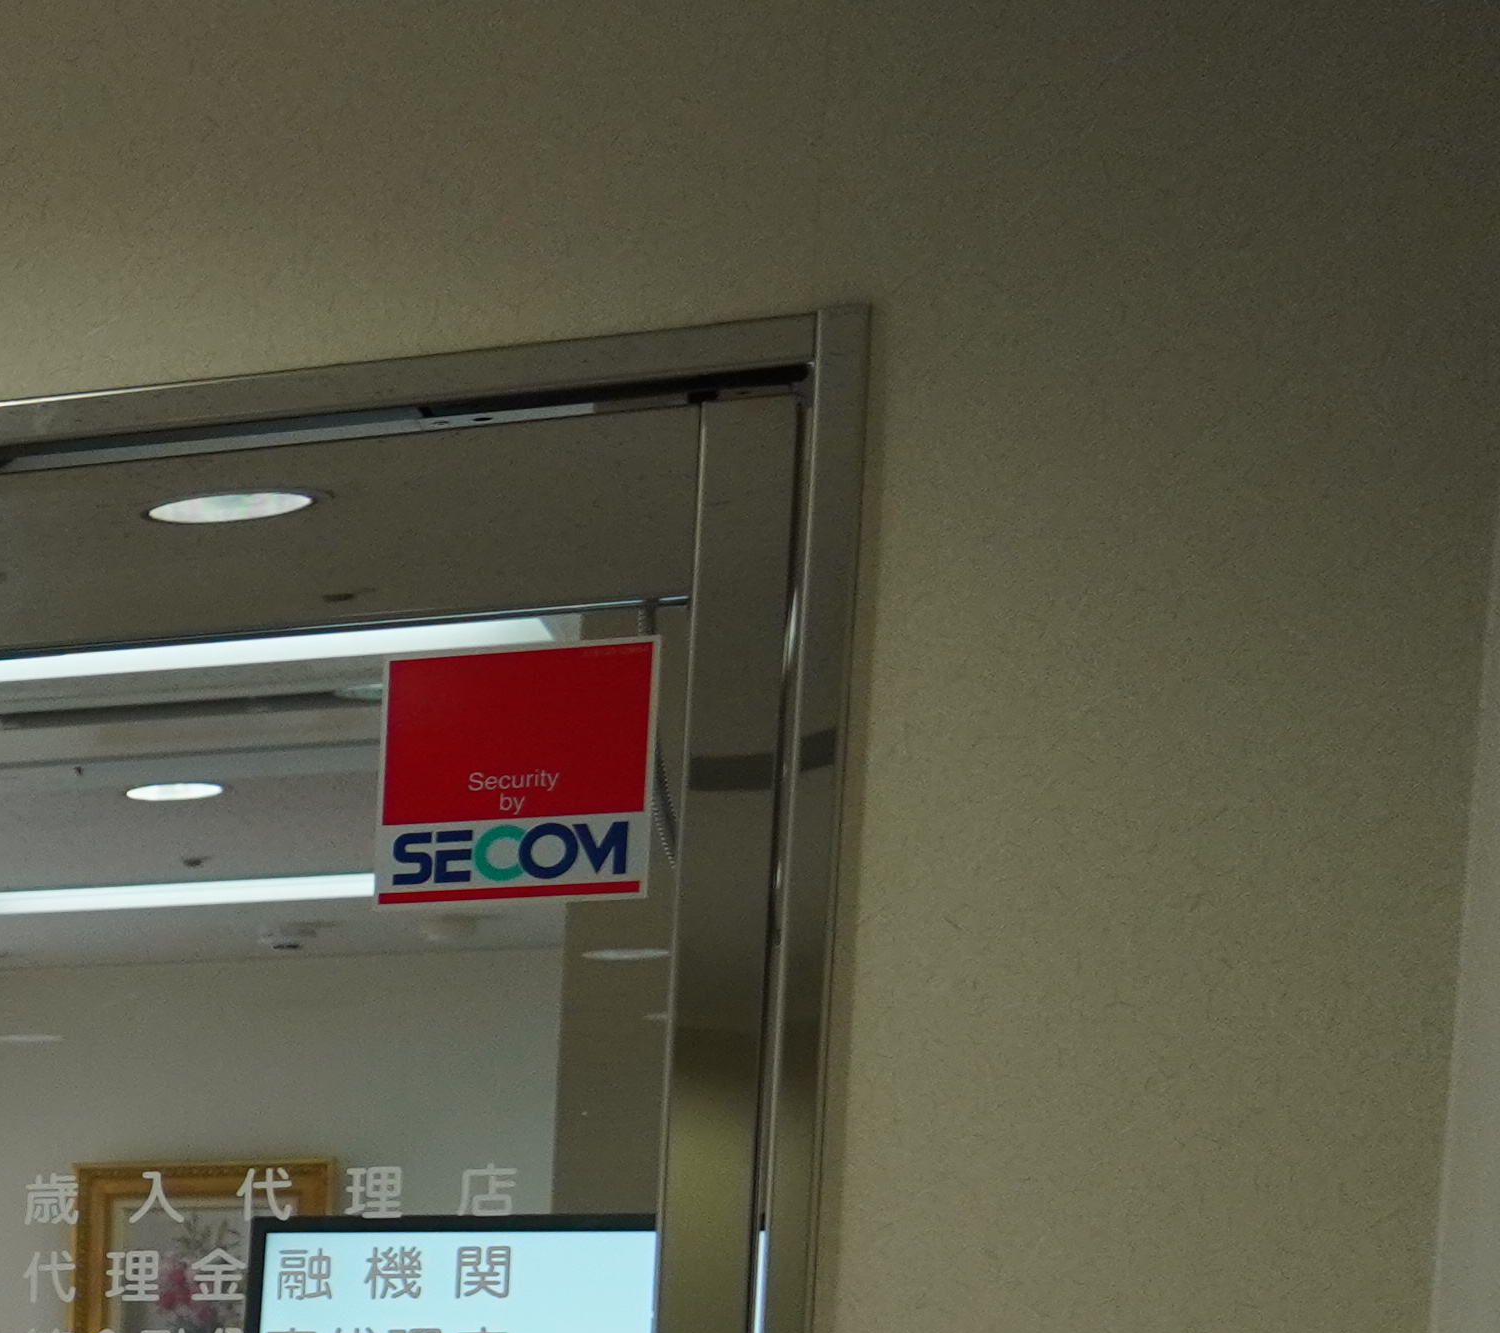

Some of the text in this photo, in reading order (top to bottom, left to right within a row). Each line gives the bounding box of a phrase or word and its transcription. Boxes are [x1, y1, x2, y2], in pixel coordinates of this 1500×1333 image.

[468, 769, 560, 792] Security
[499, 793, 525, 814] by
[392, 821, 629, 885] SECOM
